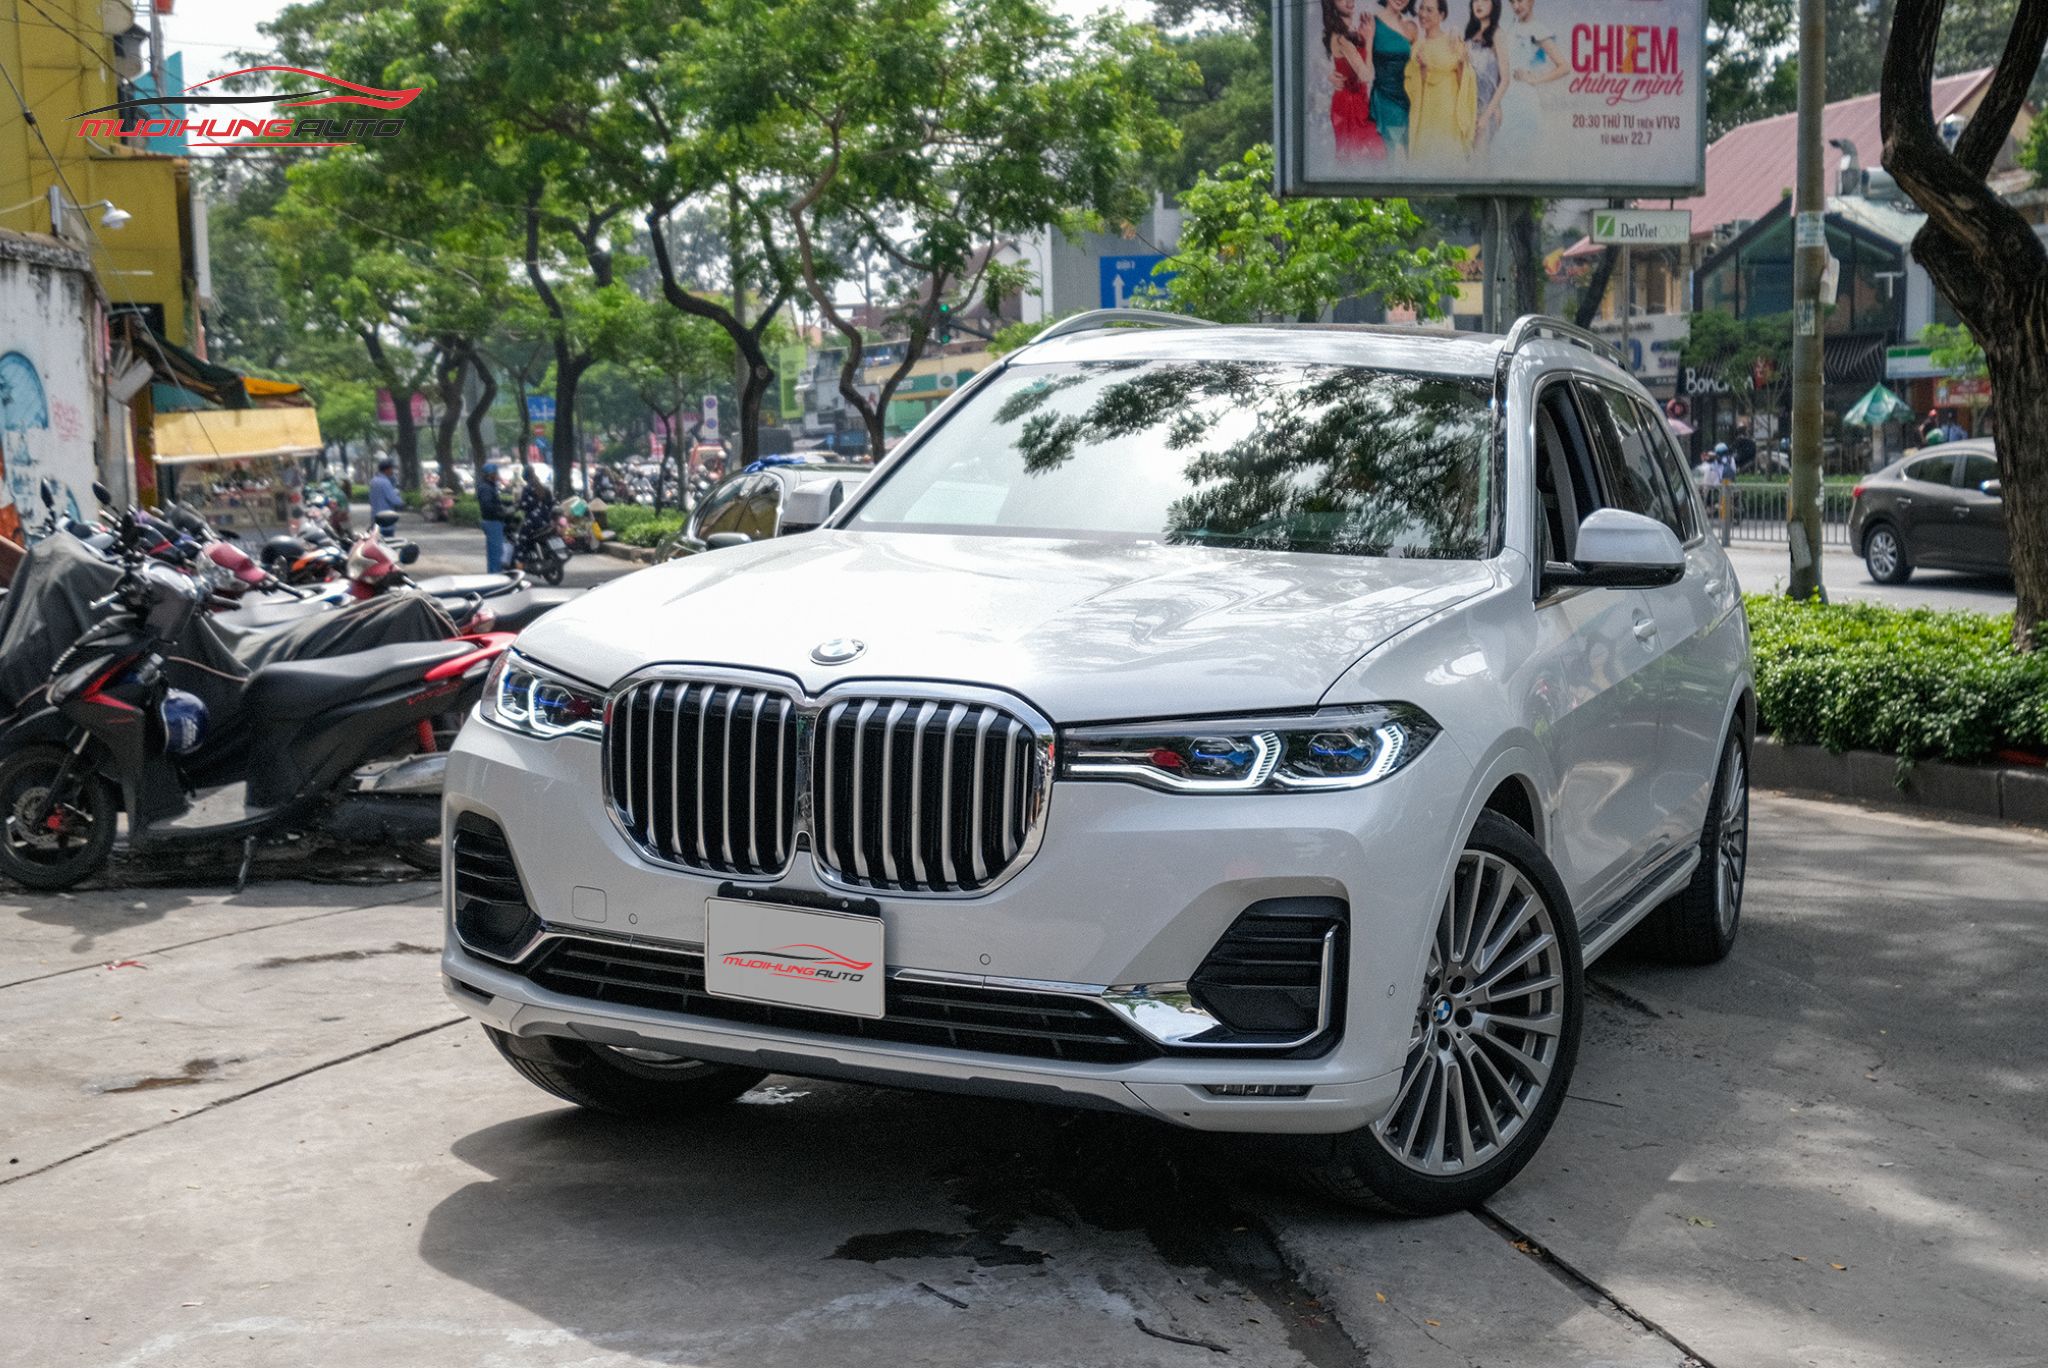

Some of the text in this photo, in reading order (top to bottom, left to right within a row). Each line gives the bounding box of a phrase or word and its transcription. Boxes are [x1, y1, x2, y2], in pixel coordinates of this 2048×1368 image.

[1572, 114, 1601, 129] 20:30
[1656, 115, 1680, 129] VTV3
[1631, 131, 1653, 145] 22.7
